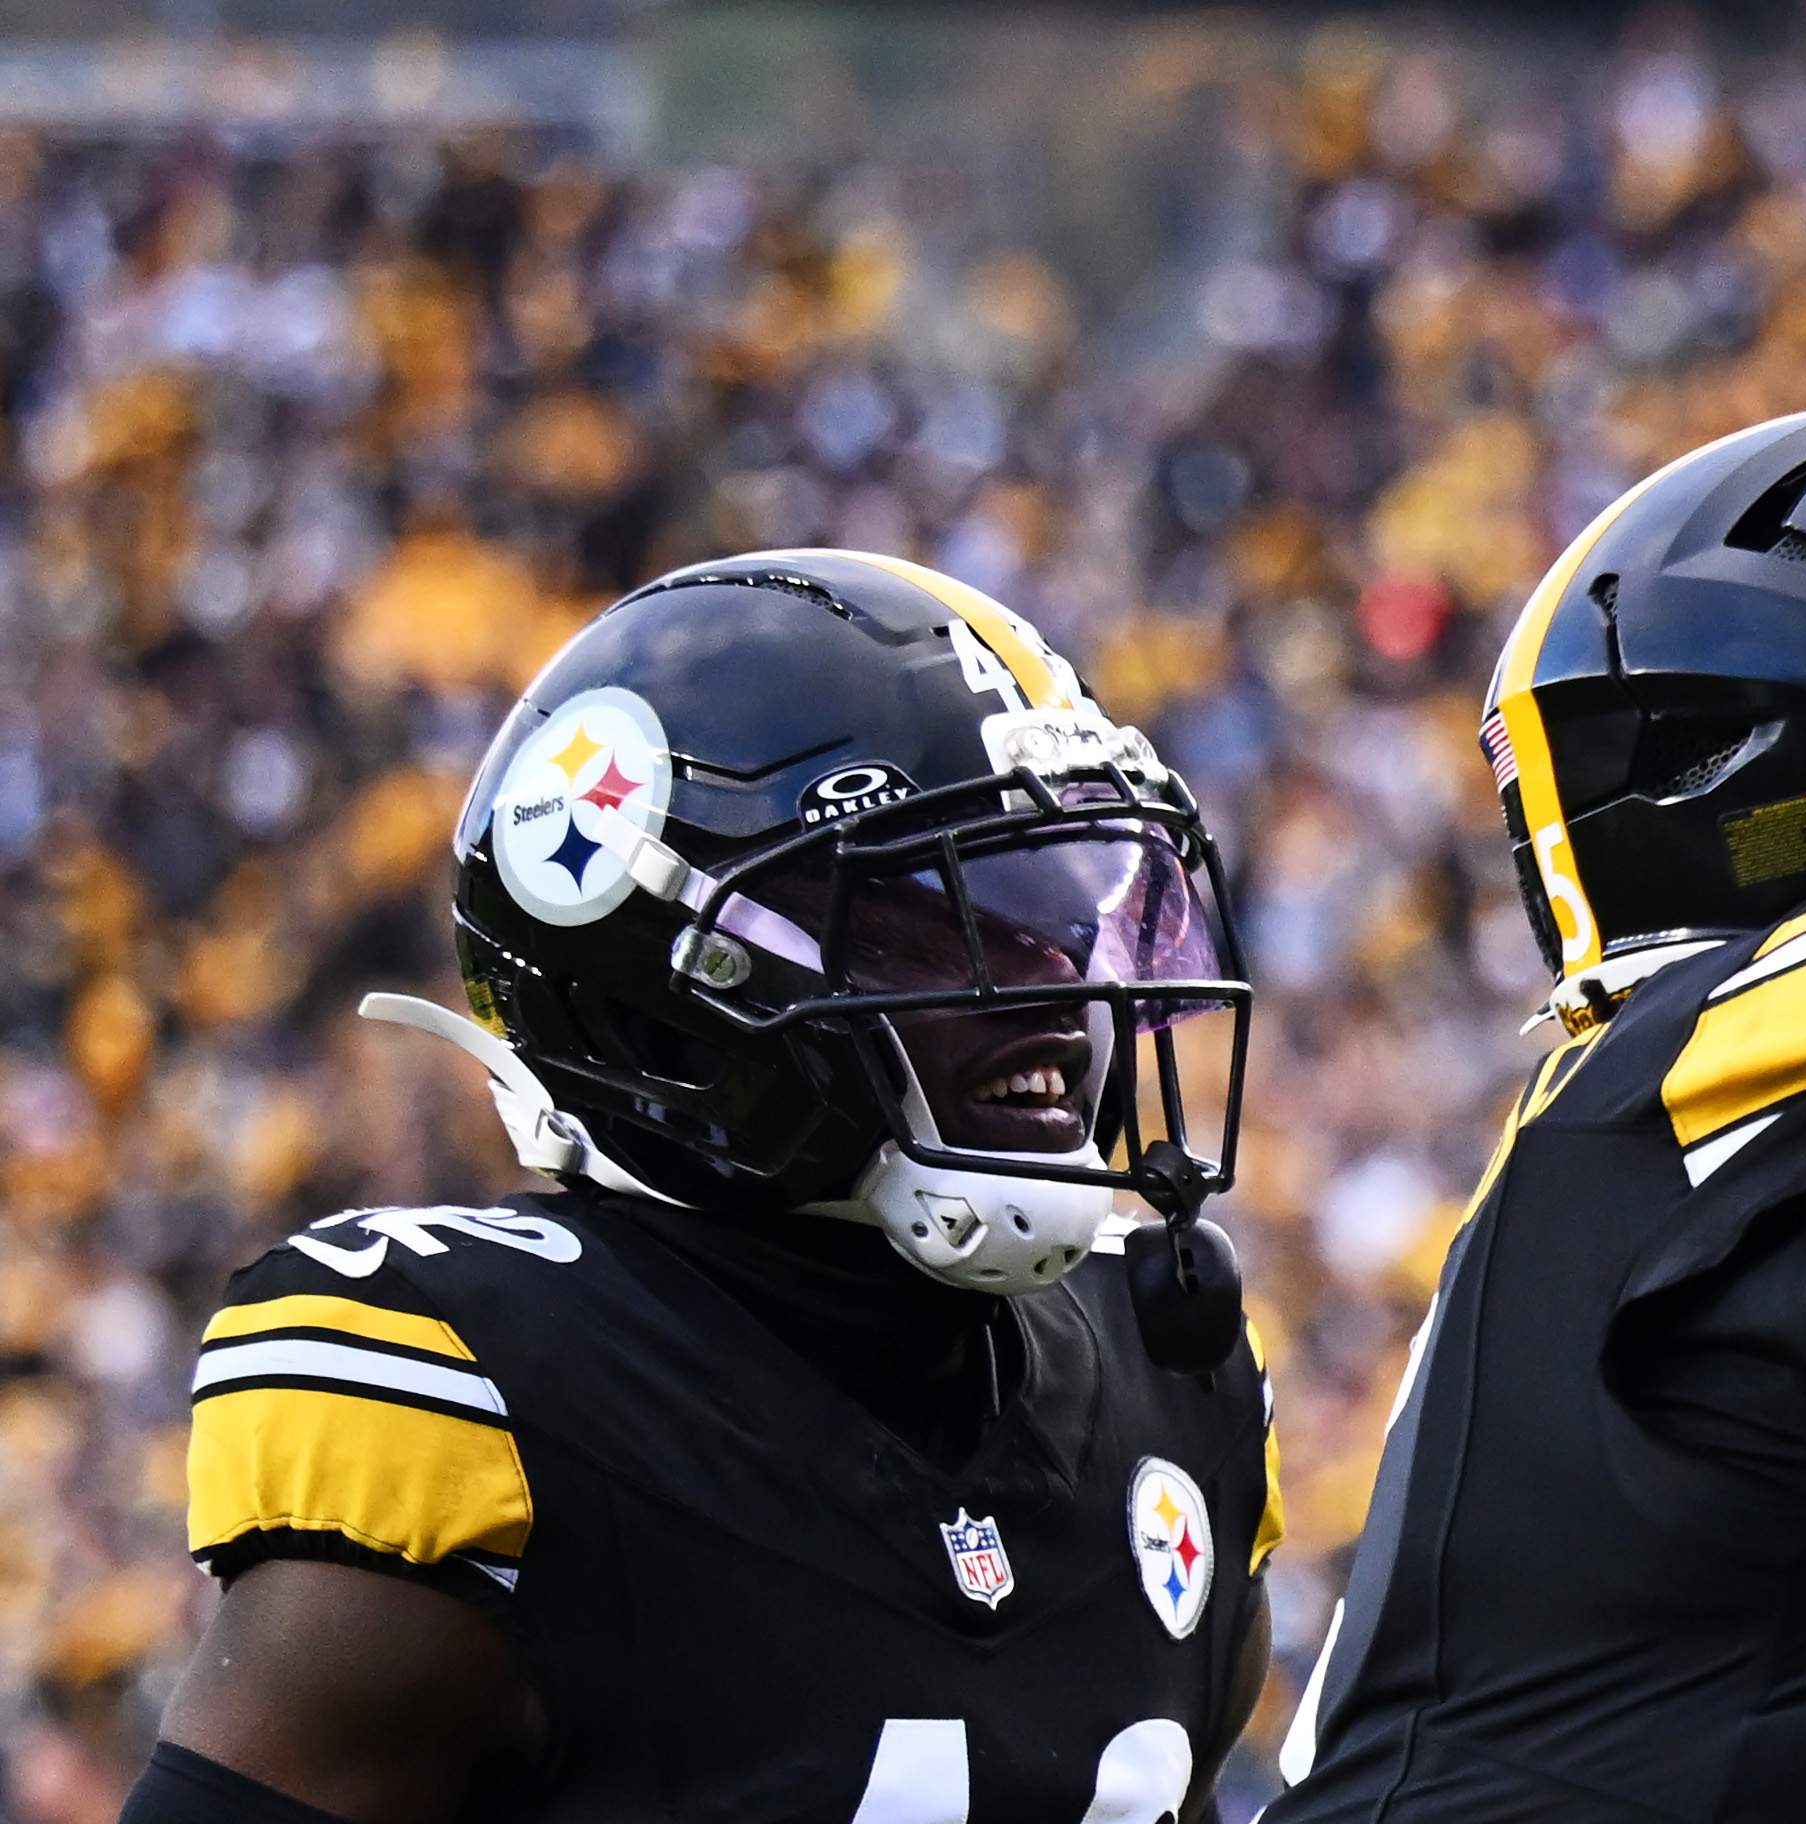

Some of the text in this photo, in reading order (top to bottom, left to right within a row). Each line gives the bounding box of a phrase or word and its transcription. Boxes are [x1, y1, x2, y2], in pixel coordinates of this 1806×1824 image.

[513, 796, 565, 826] Steelers
[804, 787, 911, 824] OAKLEY
[1535, 821, 1592, 962] 5
[961, 1552, 1005, 1590] NFL
